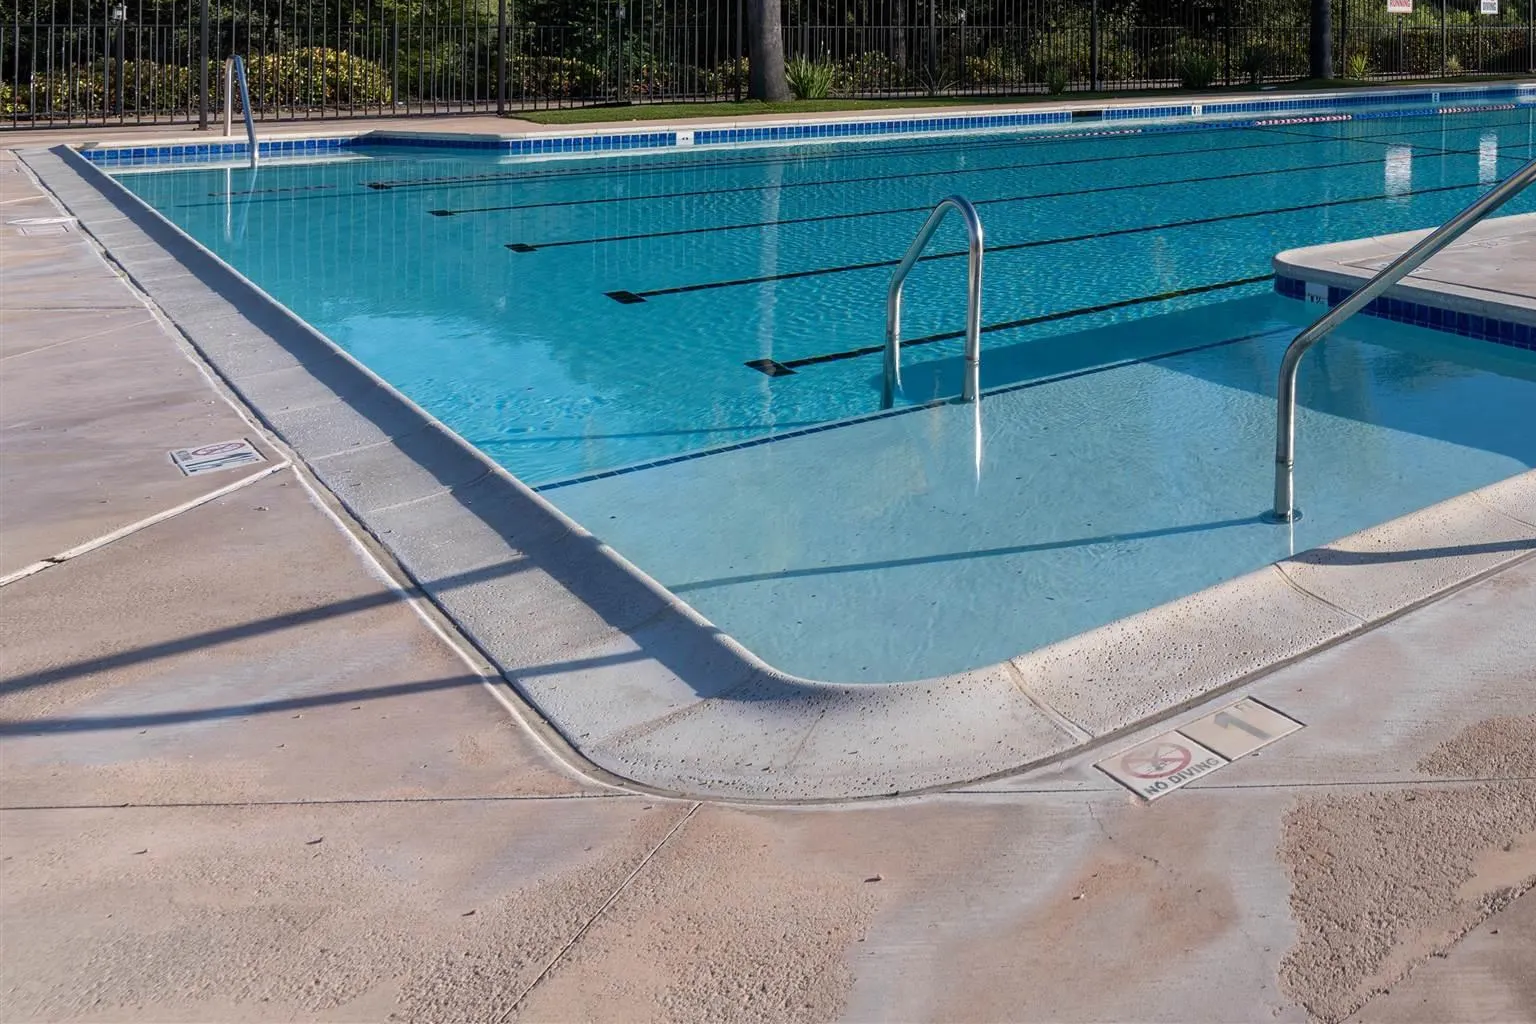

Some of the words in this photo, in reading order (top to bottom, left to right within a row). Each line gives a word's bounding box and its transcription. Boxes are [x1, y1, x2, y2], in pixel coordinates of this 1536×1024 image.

[1390, 0, 1411, 8] RUNNING
[1143, 781, 1169, 795] NO
[1168, 757, 1220, 784] DIVING
